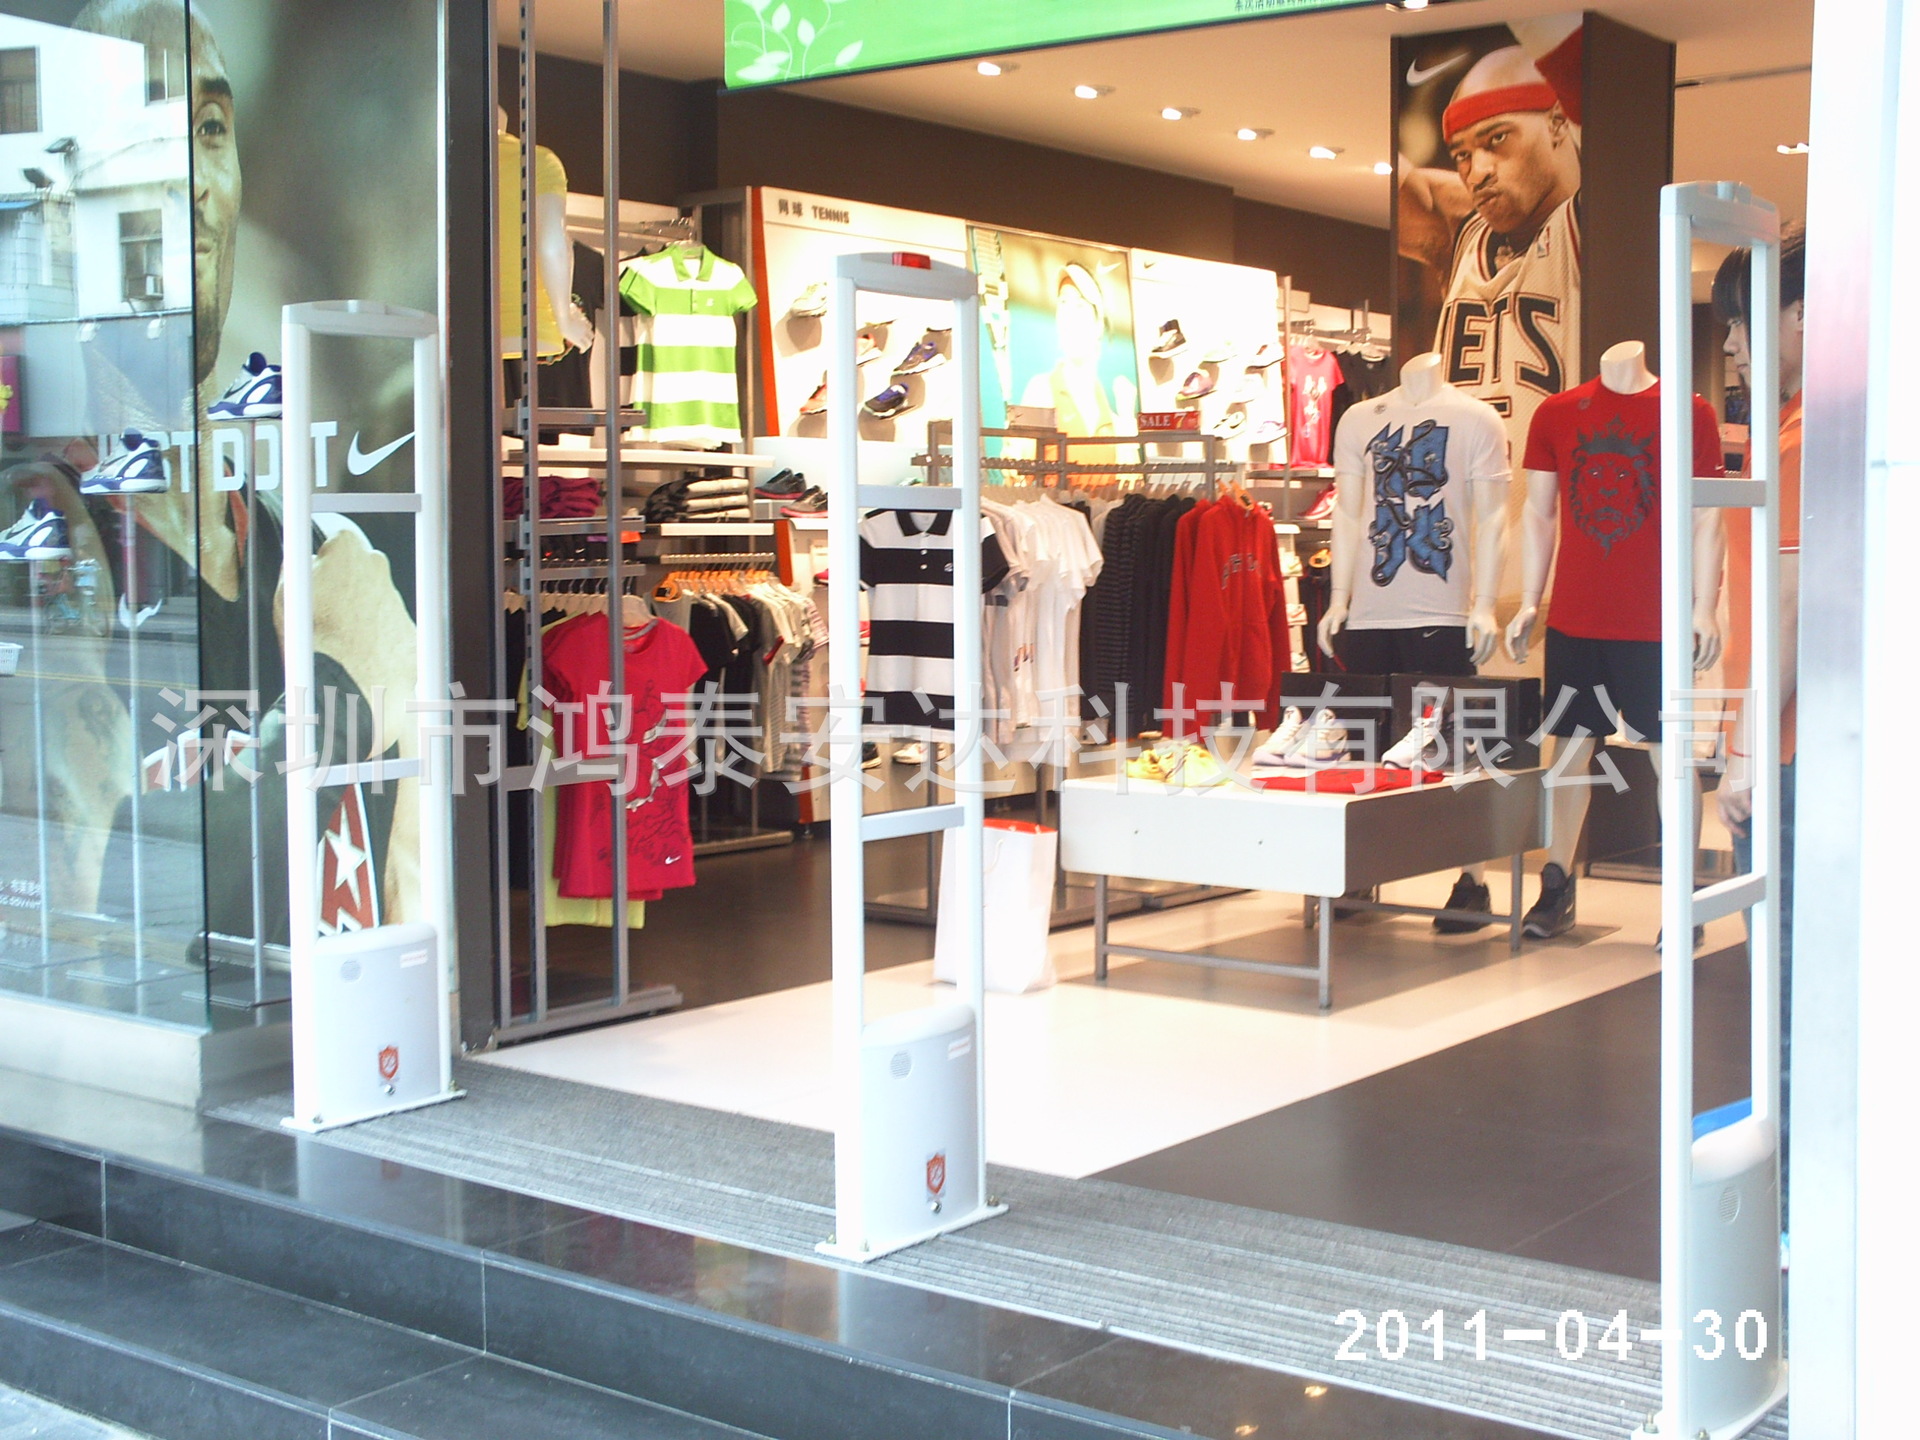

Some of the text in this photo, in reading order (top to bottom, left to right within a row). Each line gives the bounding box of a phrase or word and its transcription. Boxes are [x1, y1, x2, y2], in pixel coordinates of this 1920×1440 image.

[811, 205, 849, 224] TENNIS
[1439, 292, 1566, 396] ETS
[1140, 414, 1172, 428] SALE
[1174, 412, 1188, 429] 7
